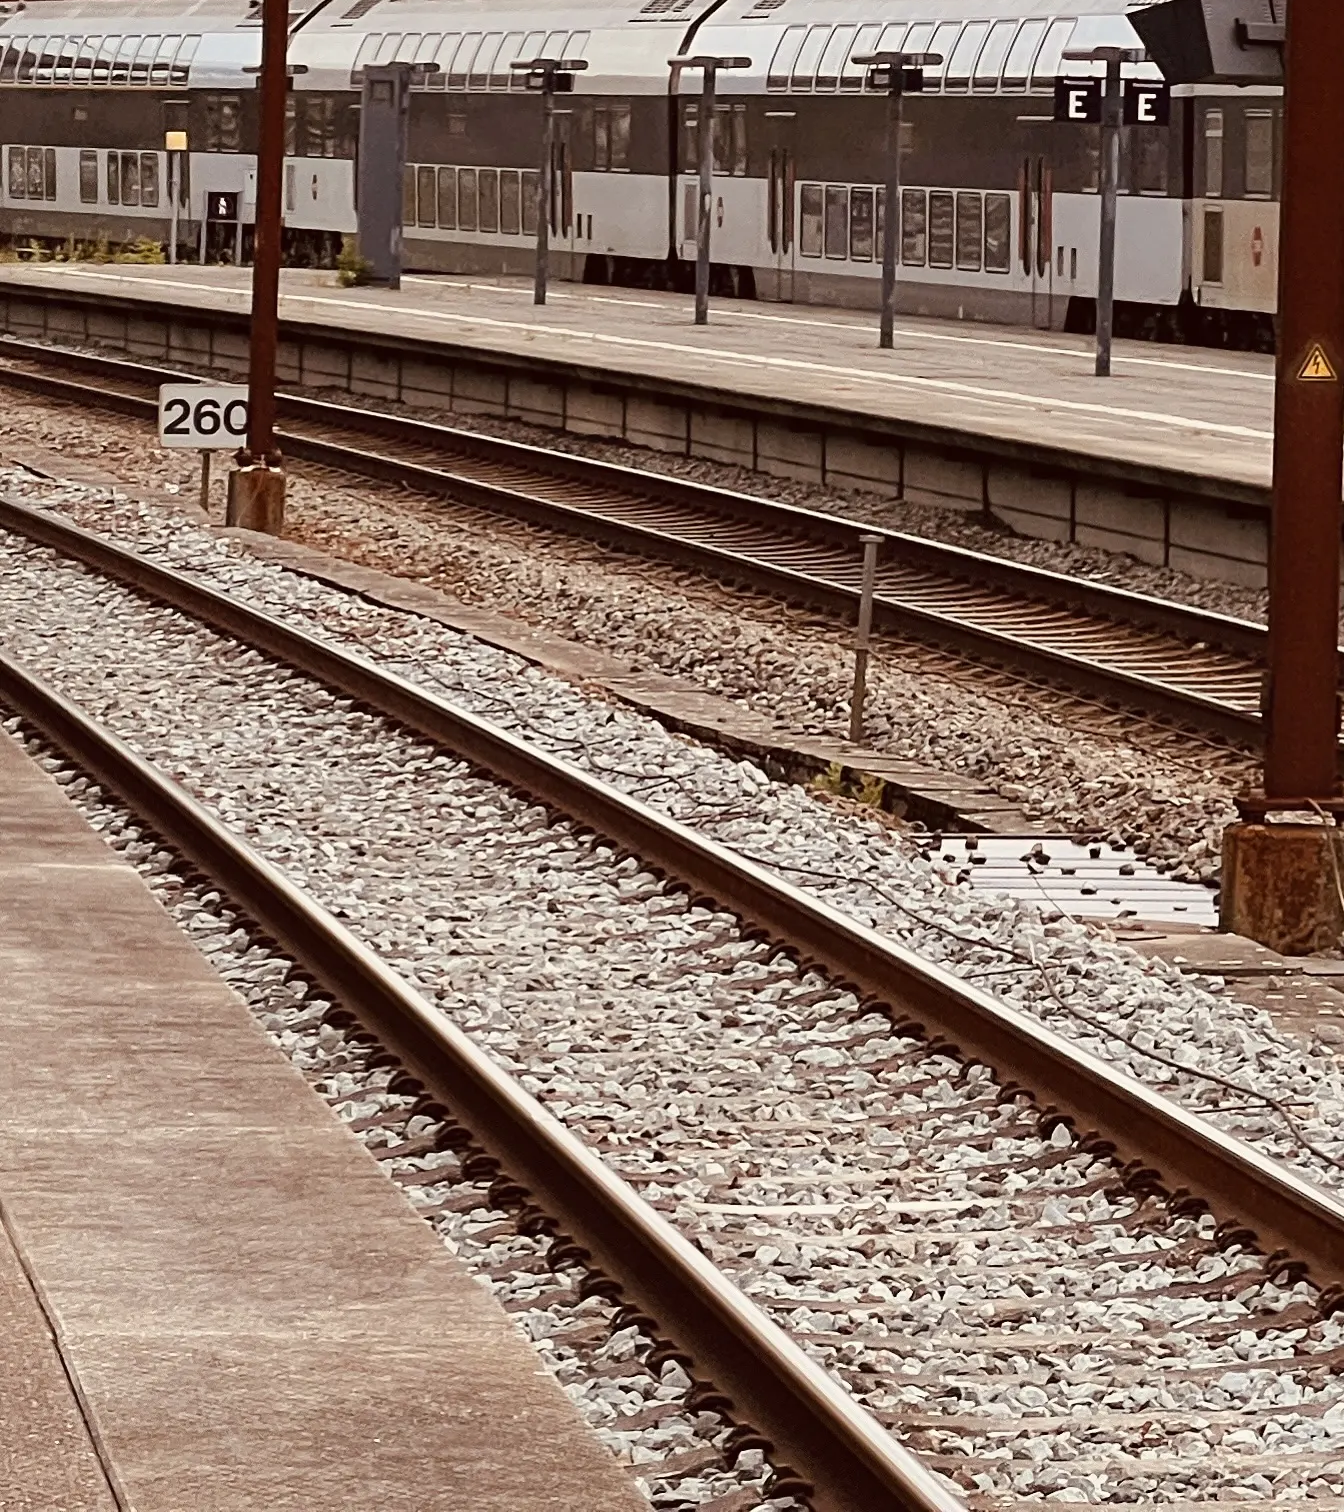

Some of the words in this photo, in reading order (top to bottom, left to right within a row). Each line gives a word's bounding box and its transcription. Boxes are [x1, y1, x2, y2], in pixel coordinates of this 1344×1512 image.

[1068, 90, 1088, 119] E
[1137, 93, 1157, 121] E
[163, 398, 248, 436] 260
